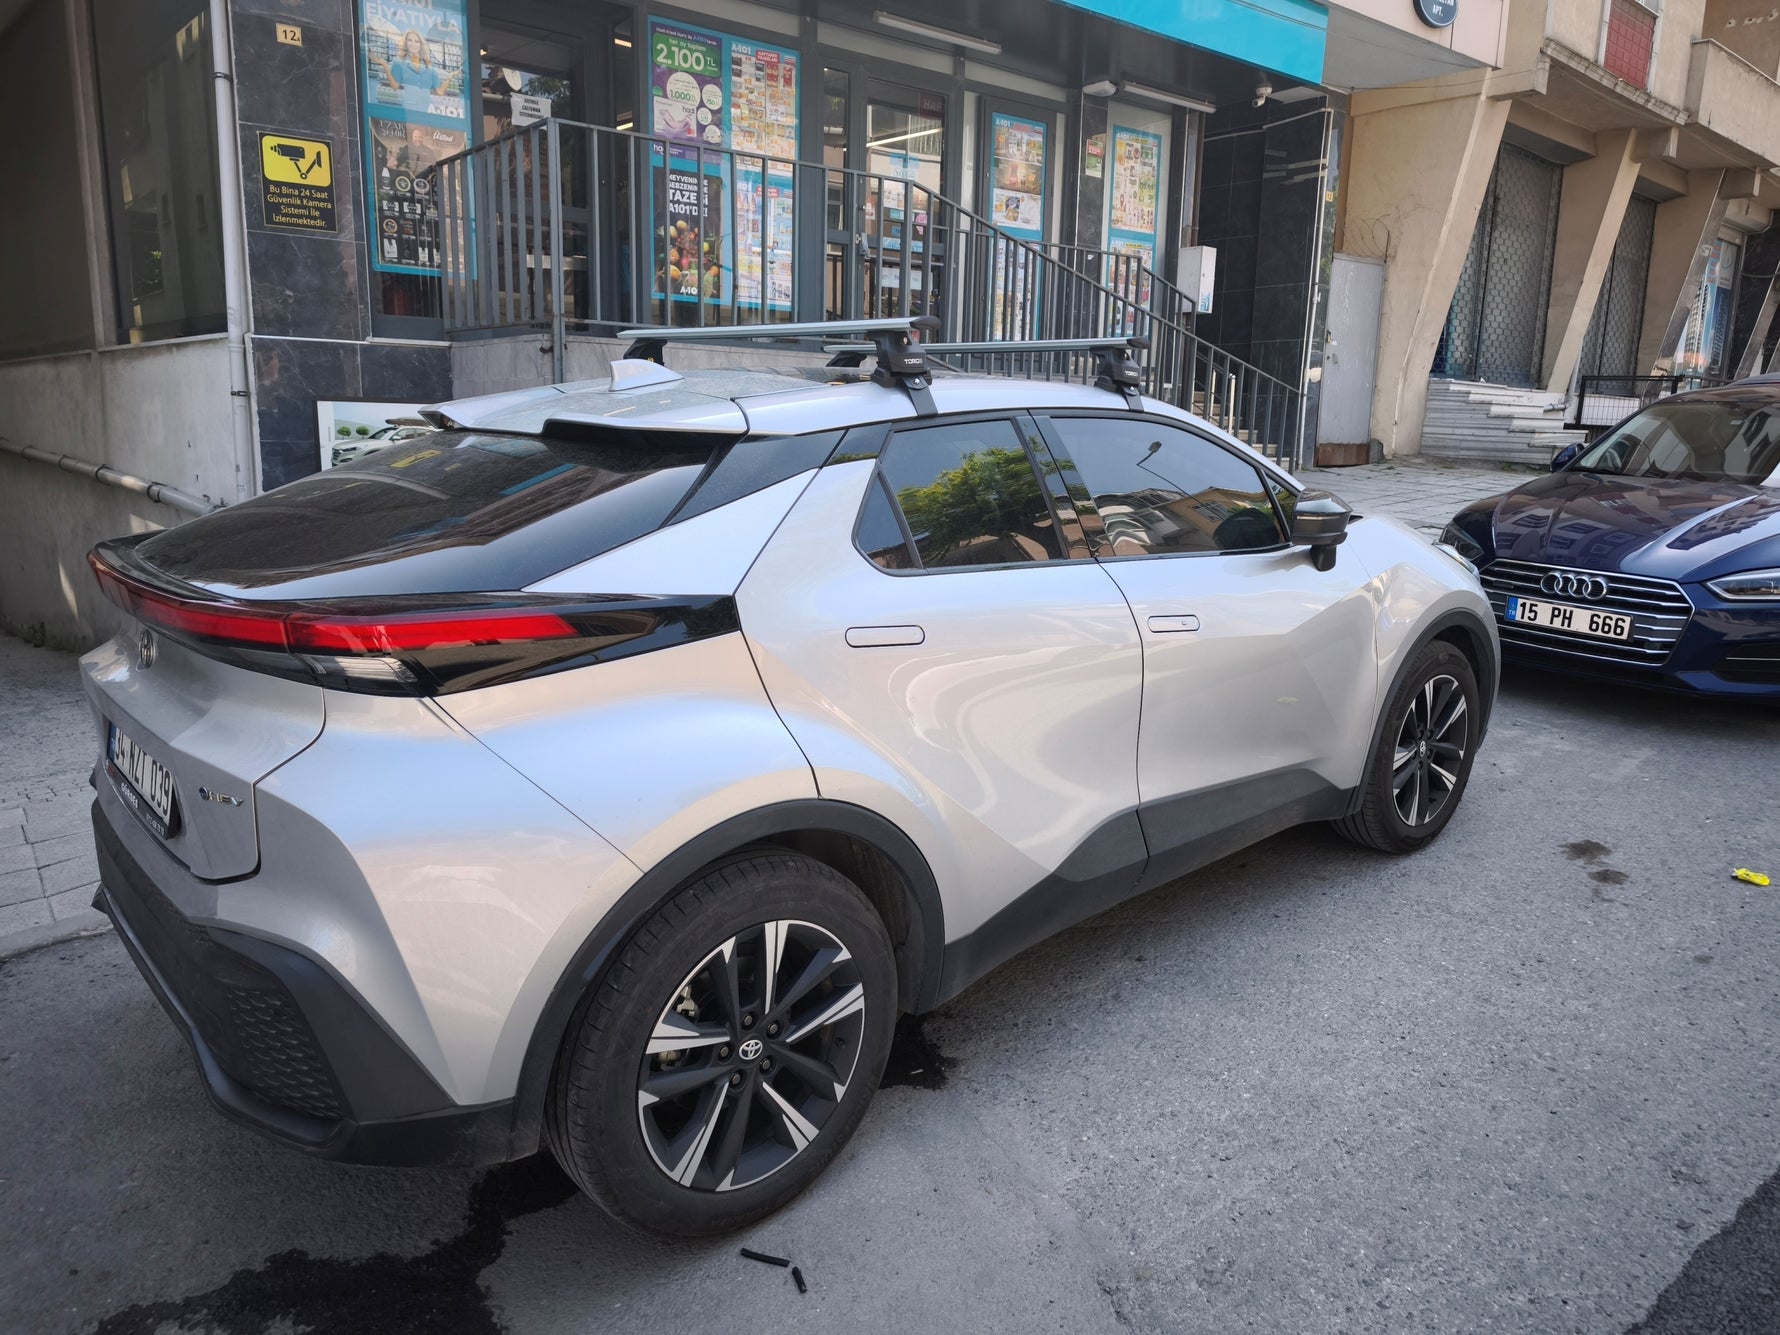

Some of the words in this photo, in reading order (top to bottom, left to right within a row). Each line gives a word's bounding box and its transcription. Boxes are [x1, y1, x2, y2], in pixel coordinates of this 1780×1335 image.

[656, 43, 705, 71] 2.100
[705, 56, 716, 67] TL
[267, 194, 302, 205] Güvenlik
[303, 198, 332, 209] Kamera
[269, 184, 280, 193] Bu
[281, 186, 299, 195] Bina
[300, 188, 310, 197] 24
[311, 189, 328, 199] Saat
[280, 205, 309, 216] Sistemi
[1520, 601, 1538, 621] 15
[1549, 606, 1573, 628] PH
[1588, 613, 1626, 636] 666
[115, 729, 125, 766] 34
[129, 740, 147, 790] NZT
[150, 759, 171, 817] 039
